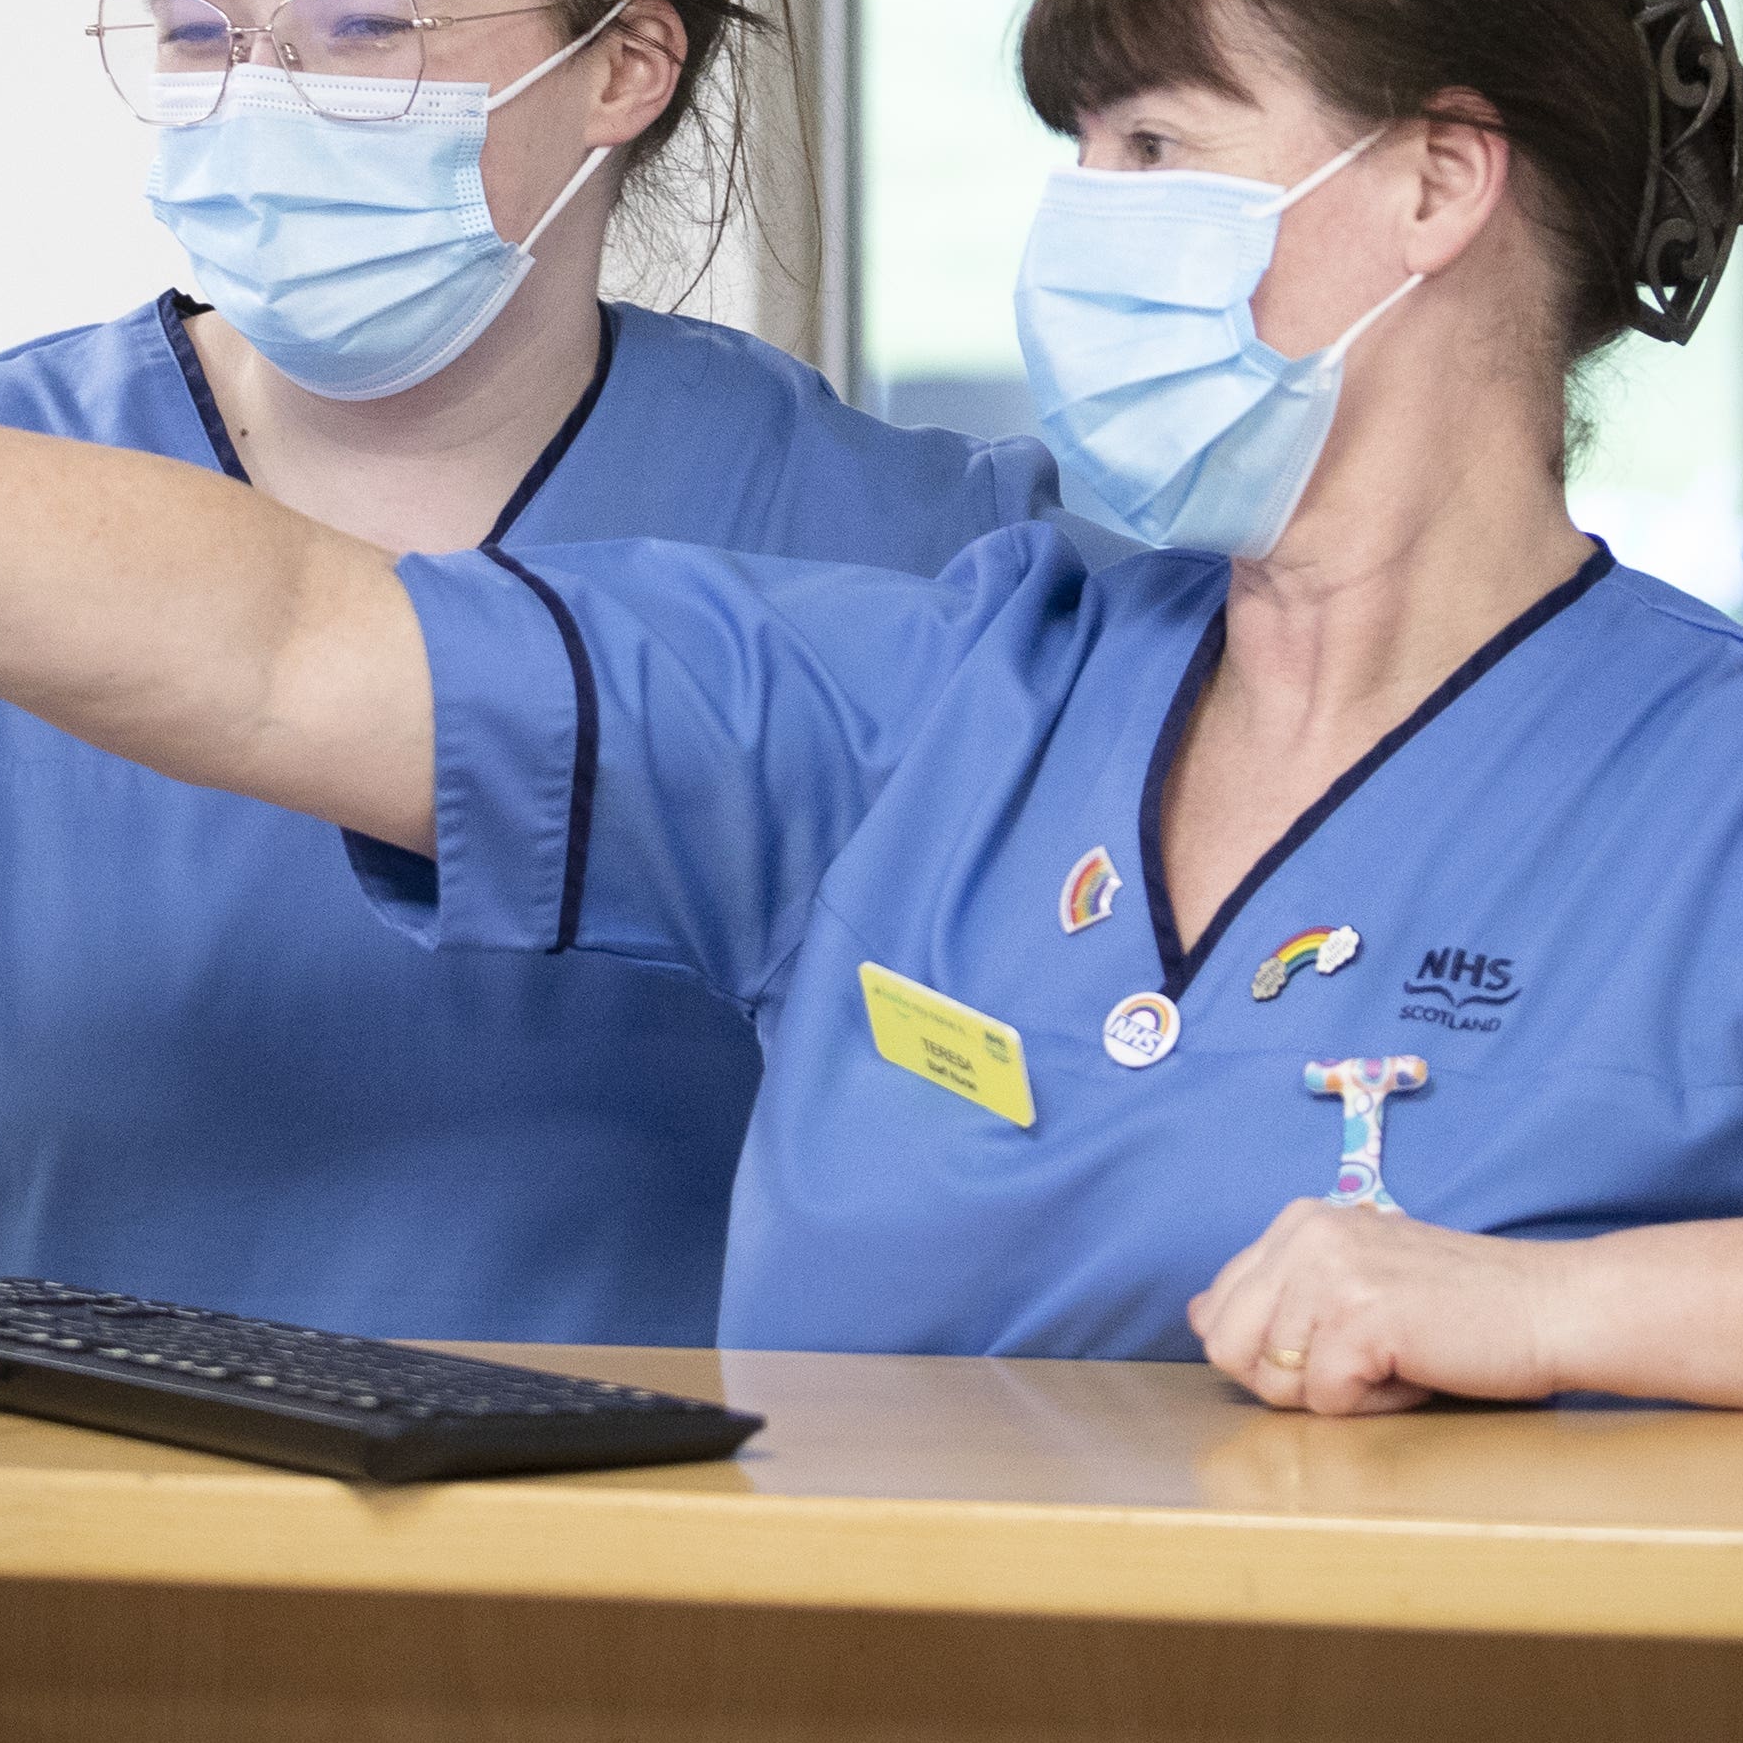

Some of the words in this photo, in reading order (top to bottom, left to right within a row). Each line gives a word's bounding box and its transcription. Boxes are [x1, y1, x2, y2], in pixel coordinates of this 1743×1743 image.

[1416, 946, 1513, 991] NHS
[1105, 1015, 1163, 1056] NHS
[1398, 1005, 1502, 1032] SCOTLAND
[921, 1036, 976, 1074] TERESA
